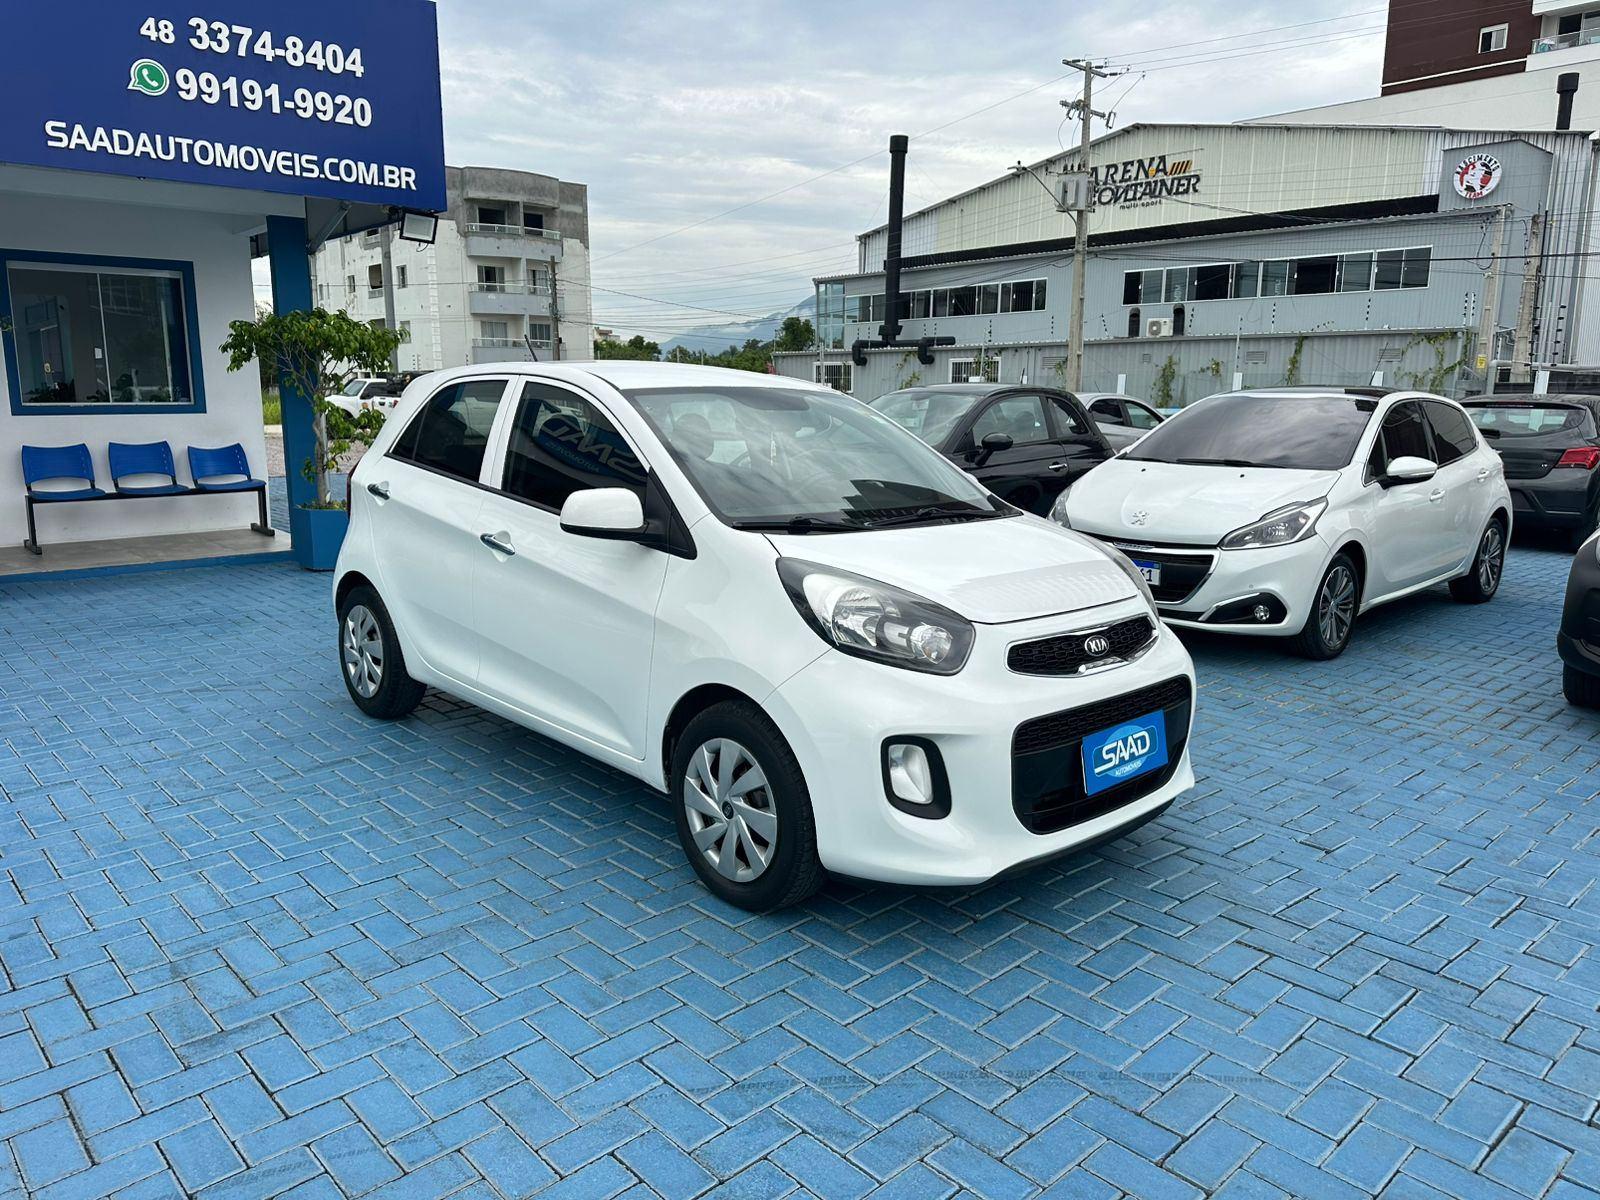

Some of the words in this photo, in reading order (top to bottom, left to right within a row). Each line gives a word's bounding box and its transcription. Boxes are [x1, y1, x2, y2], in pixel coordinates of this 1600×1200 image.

[139, 17, 175, 45] 48
[187, 16, 365, 77] 3374-8404
[175, 68, 373, 128] 99191-9920
[44, 120, 417, 191] SAADAUTOMOVEIS.COM.BR
[1090, 154, 1169, 186] ARENA
[1119, 202, 1138, 210] multi
[1141, 199, 1163, 208] sport
[1089, 638, 1109, 654] KIA
[1094, 730, 1151, 776] SAAD
